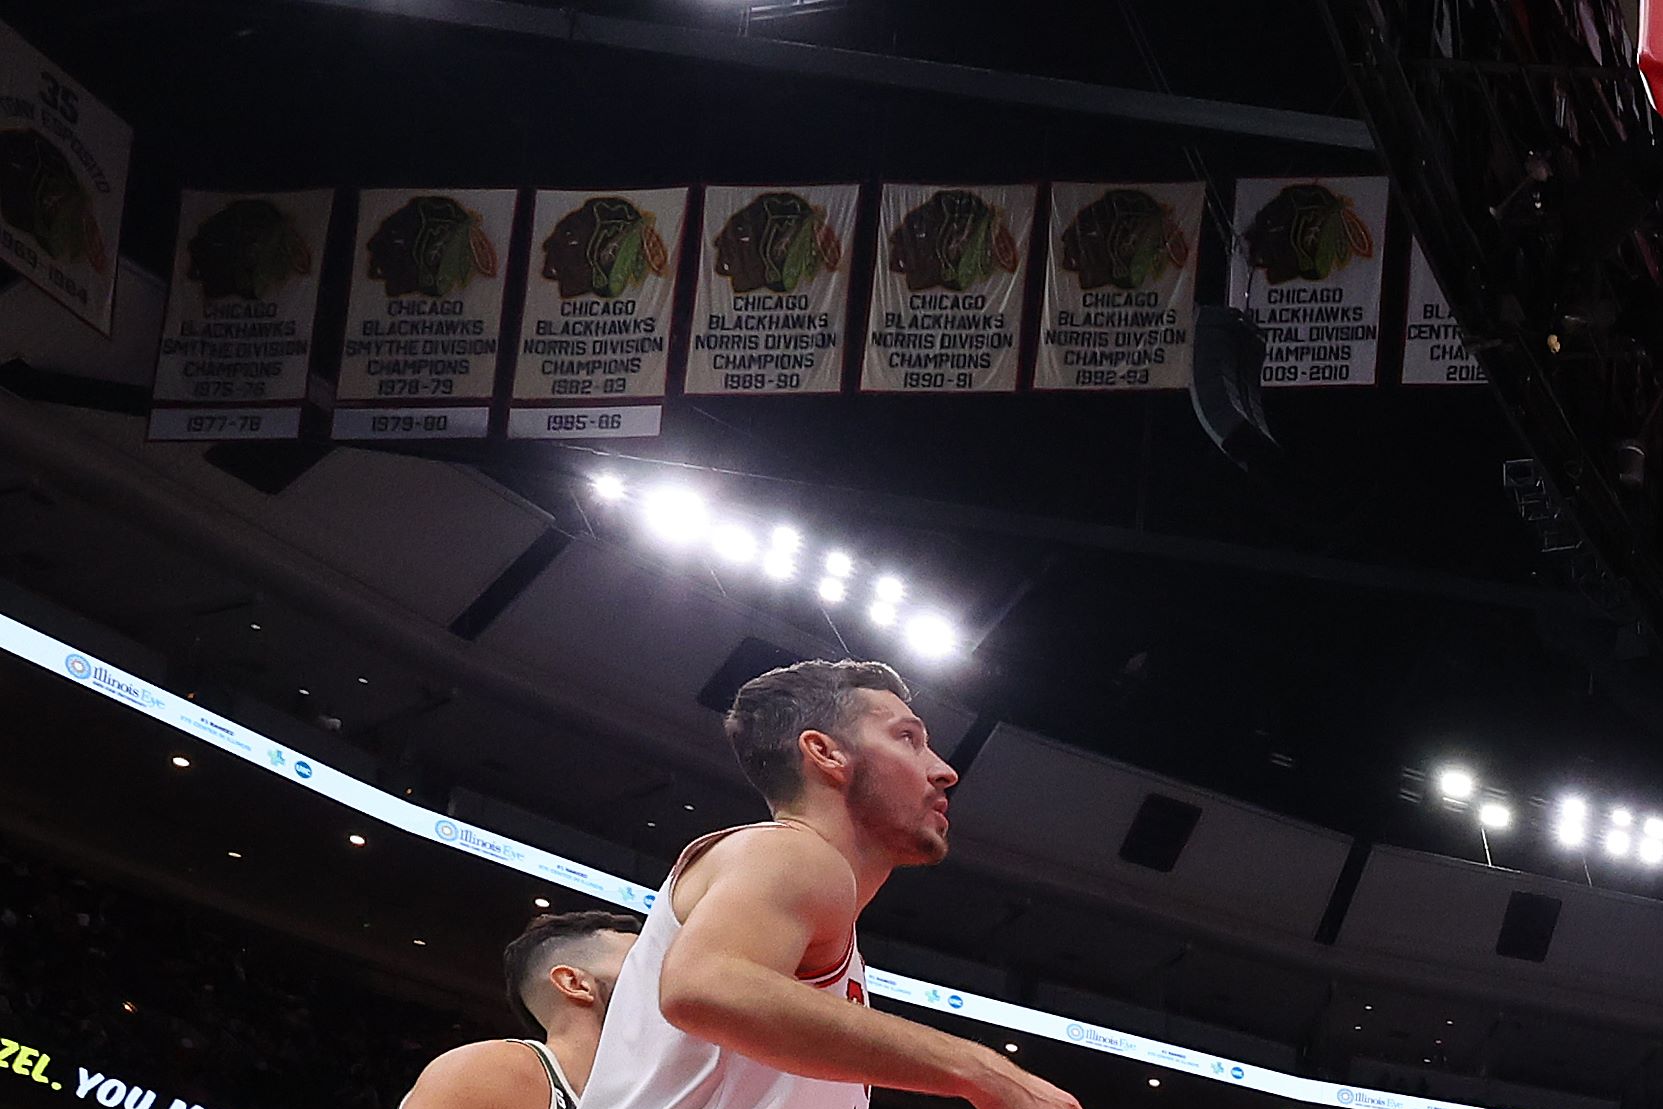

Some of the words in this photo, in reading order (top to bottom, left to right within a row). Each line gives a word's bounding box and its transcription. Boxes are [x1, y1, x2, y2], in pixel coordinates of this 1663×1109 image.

[734, 295, 808, 311] CHICAGO
[910, 295, 985, 310] CHICAGO
[1083, 293, 1158, 308] CHICAGO
[1268, 288, 1343, 303] CHICAGO
[204, 303, 277, 318] CHICAGO
[388, 301, 463, 316] CHICAGO
[561, 301, 635, 317] CHICAGO
[1250, 307, 1363, 324] LACKHAWKS
[709, 314, 828, 330] BLACKHAWKS
[885, 313, 1004, 329] BLACKHAWKS
[1058, 310, 1176, 327] BLACKHAWKS
[182, 321, 296, 337] BLACKHAWKS
[363, 320, 484, 336] BLACKHAWKS
[536, 318, 655, 336] BLACKHAWKS
[1309, 325, 1376, 341] DIVISION
[695, 334, 758, 350] NORRIS
[765, 333, 836, 349] DIVISION
[872, 332, 934, 348] NORRIS
[940, 333, 1013, 348] DIVISION
[1045, 330, 1108, 346] NORRIS
[1115, 329, 1186, 346] DIVISION
[163, 339, 234, 357] SMYTHE
[236, 340, 307, 356] DIVISION
[346, 339, 418, 356] SMYTHE
[422, 339, 496, 355] DIVISION
[524, 339, 586, 355] NORRIS
[592, 337, 663, 354] DIVISION
[1266, 345, 1351, 361] HAMPIONS
[713, 353, 814, 370] CHAMPIONS
[889, 353, 991, 369] CHAMPIONS
[1064, 349, 1165, 366] CHAMPIONS
[184, 361, 281, 377] CHAMPIONS
[368, 360, 470, 376] CHAMPIONS
[542, 358, 641, 375] CHAMPIONS
[1262, 365, 1350, 382] 009-2010
[93, 667, 139, 697] Illinois
[140, 689, 165, 709] Eye
[460, 829, 501, 854] Illinois
[502, 844, 524, 861] Eye
[1086, 1029, 1118, 1045] Illinois
[1119, 1038, 1136, 1050] Eye
[1355, 1092, 1386, 1105] Illinois
[1387, 1099, 1403, 1109] Eye
